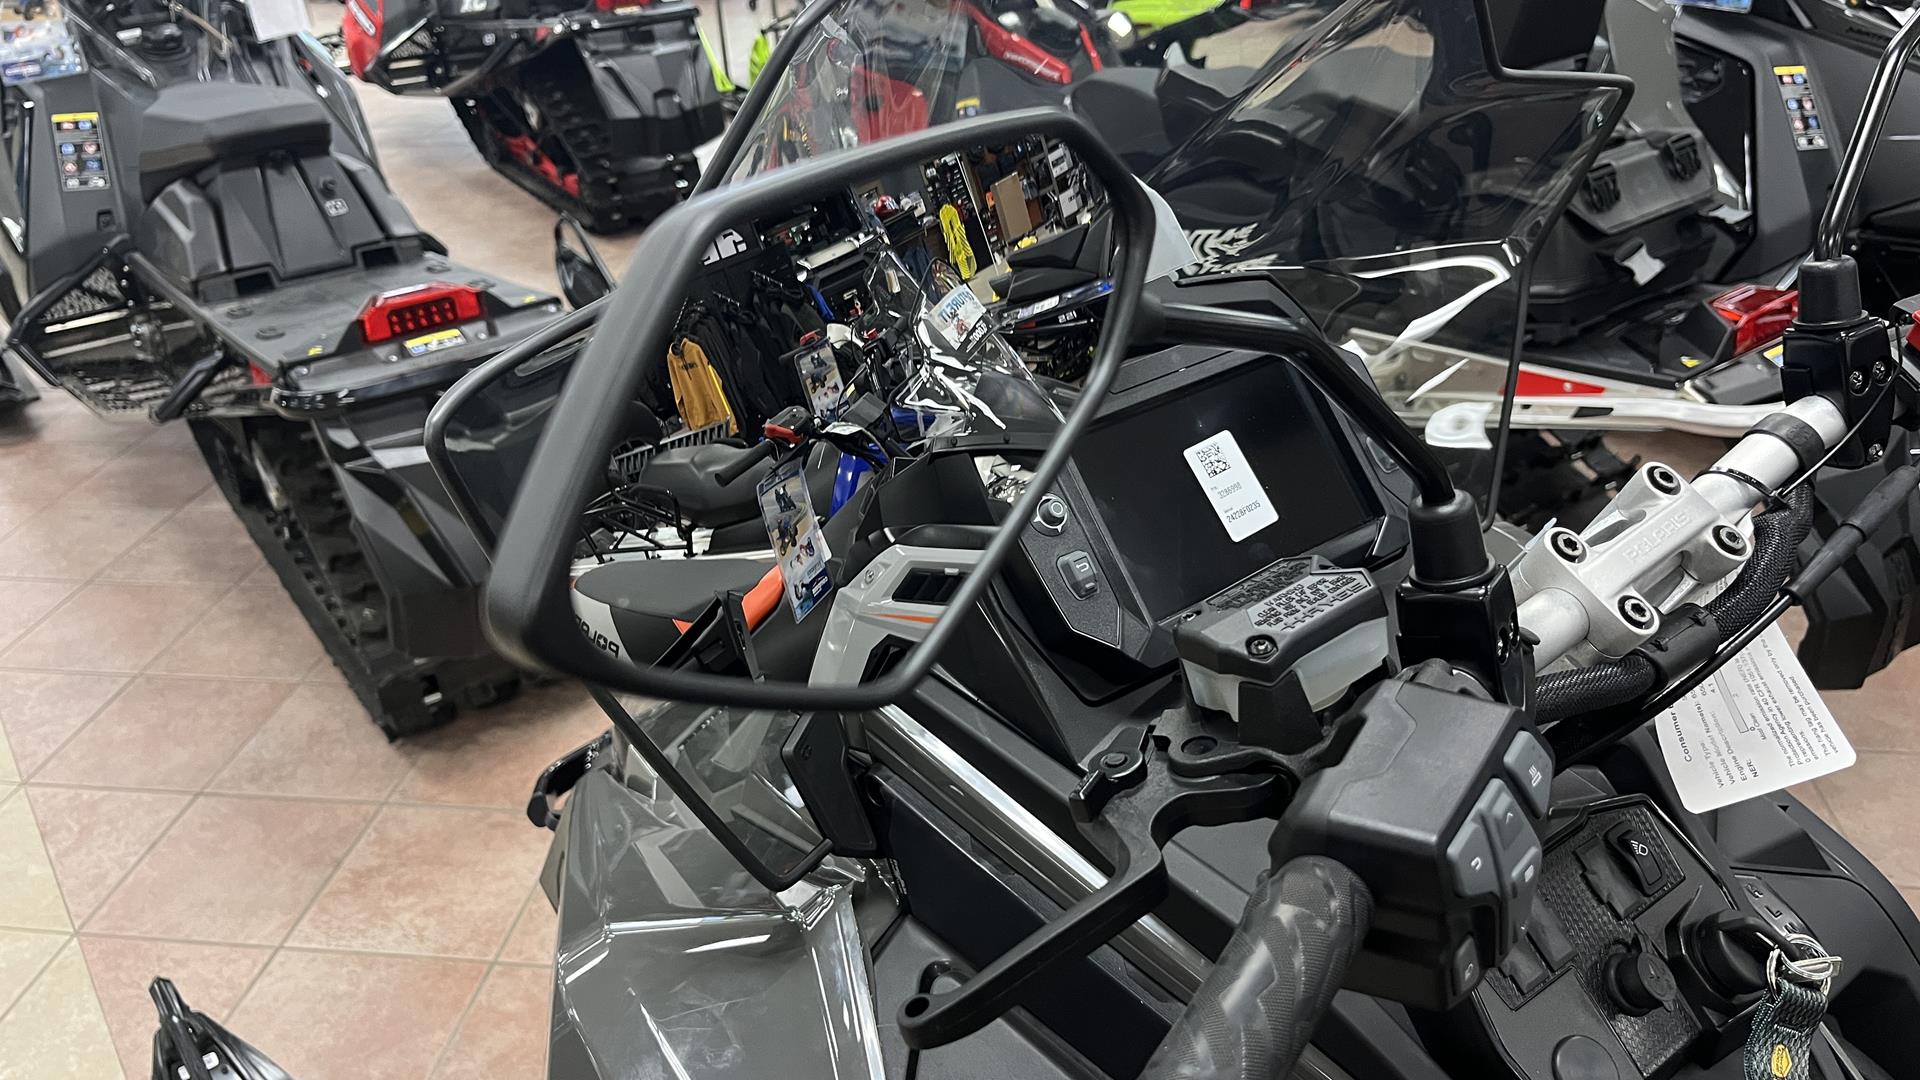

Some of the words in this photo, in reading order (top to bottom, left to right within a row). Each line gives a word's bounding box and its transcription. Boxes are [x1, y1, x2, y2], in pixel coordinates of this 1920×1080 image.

[1623, 510, 1691, 561] POLARIS
[1753, 683, 1764, 697] CFR
[1761, 680, 1776, 704] exhaust
[1776, 669, 1794, 695] removed
[1753, 695, 1770, 722] emission
[1774, 704, 1786, 721] lower
[1805, 705, 1818, 721] been
[1669, 710, 1692, 761] Consumer
[1770, 712, 1787, 735] Agency
[1810, 727, 1823, 743] hang
[1707, 734, 1721, 755] Model
[1767, 722, 1788, 755] normalized
[1782, 734, 1803, 765] Protection
[1783, 720, 1808, 758] representing
[1819, 743, 1831, 755] This
[1820, 731, 1839, 754] vehicle
[1718, 758, 1737, 786] Vehicle
[1730, 755, 1748, 781] Engine
[1745, 759, 1759, 777] NER:
[1785, 755, 1795, 767] The
[1708, 762, 1725, 788] Vehicle
